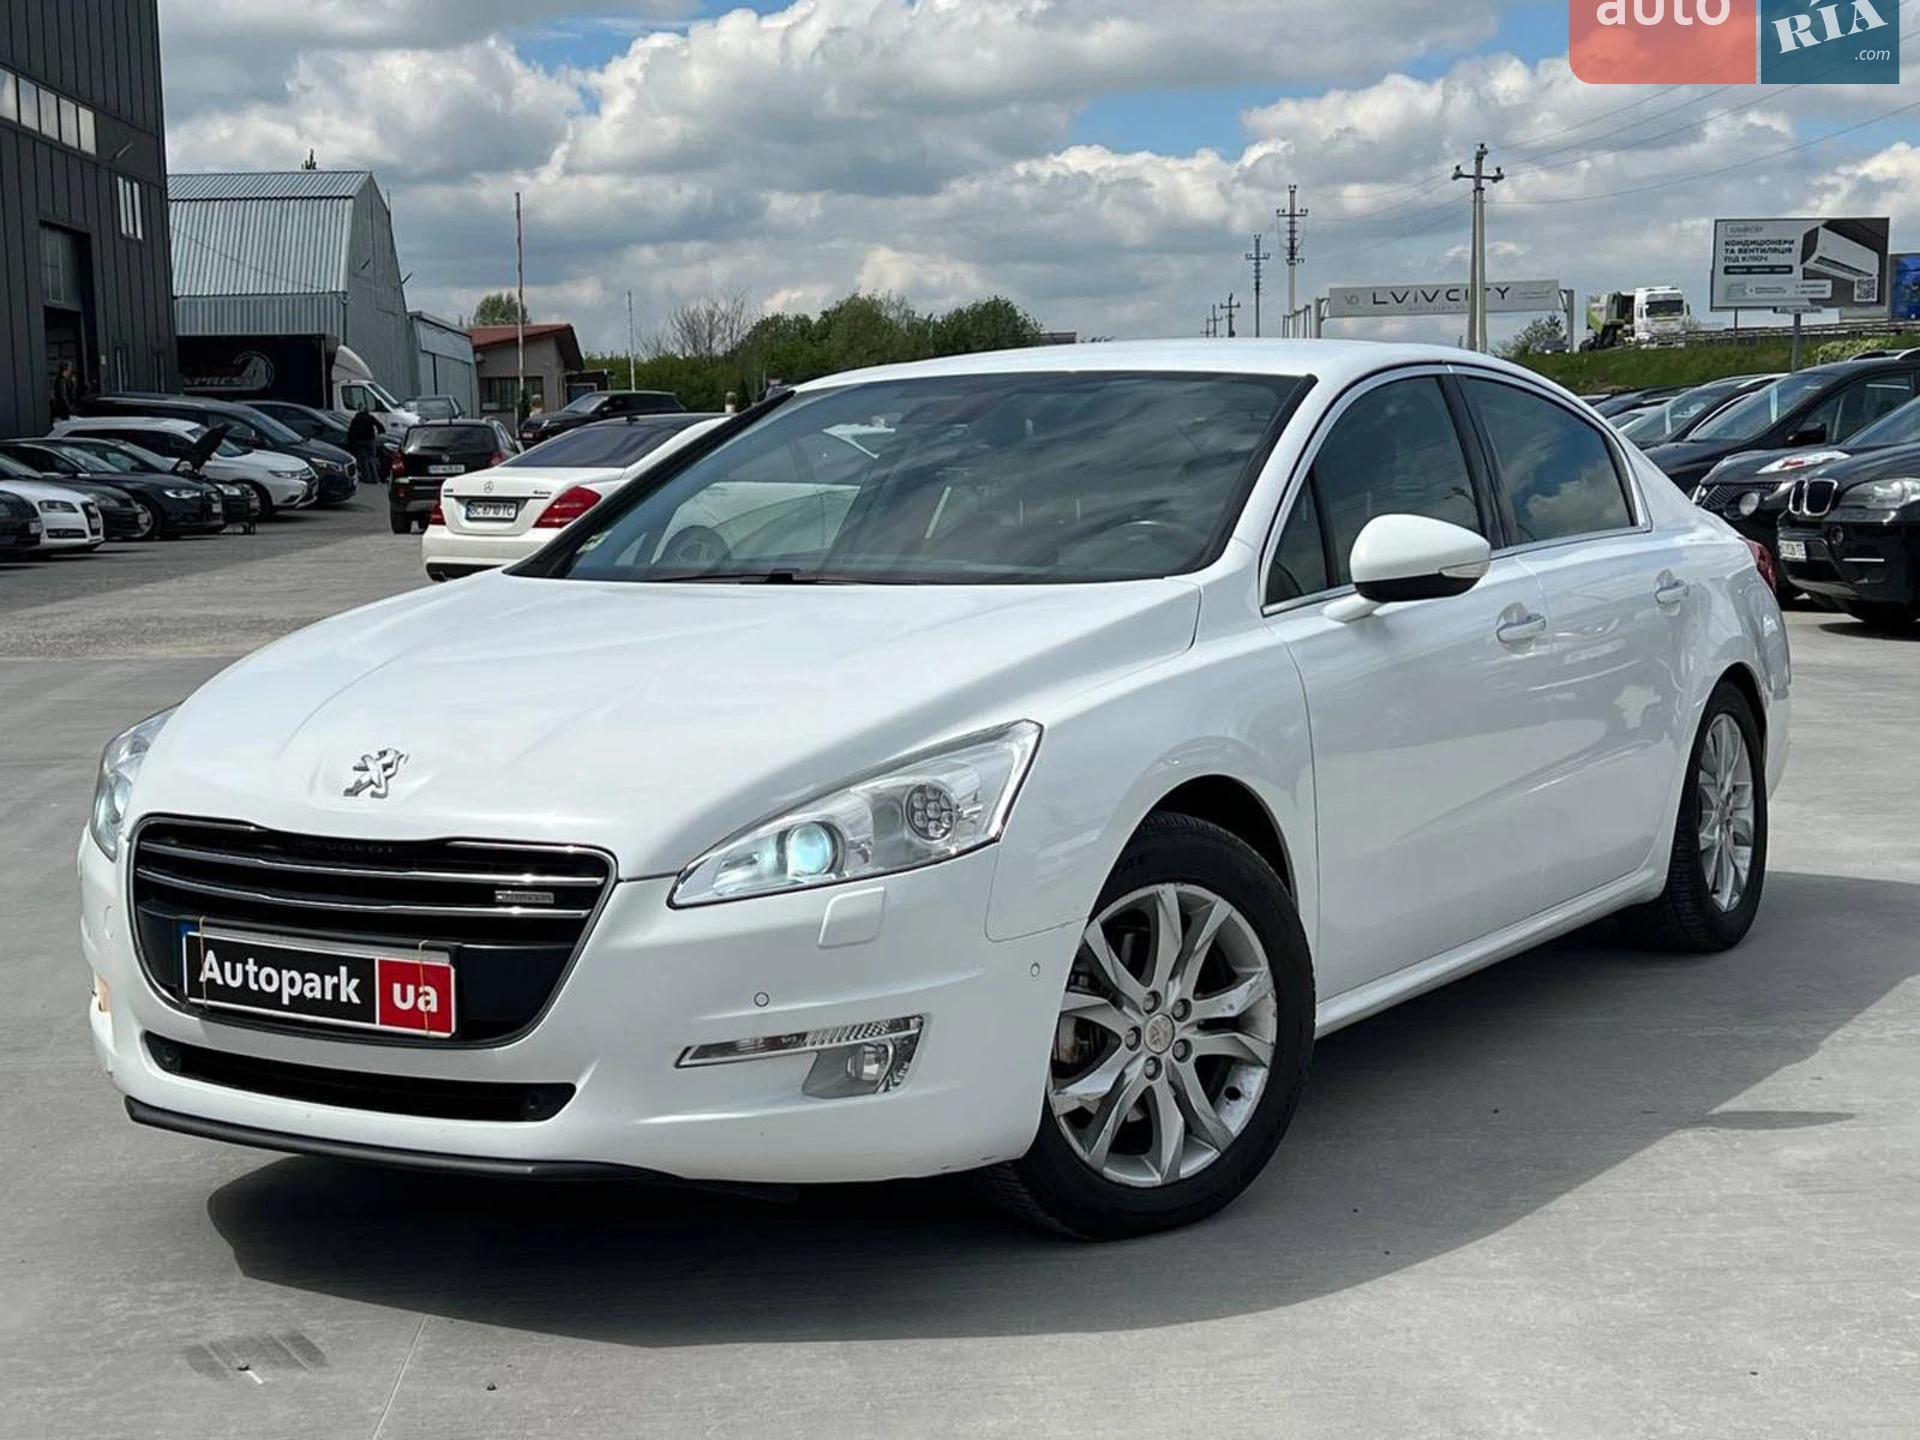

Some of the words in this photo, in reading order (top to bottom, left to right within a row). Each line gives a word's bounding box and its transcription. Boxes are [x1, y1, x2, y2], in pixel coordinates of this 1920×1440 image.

[1372, 287, 1511, 305] LVIVCIY
[199, 949, 361, 1005] Autopark
[392, 981, 438, 1013] ua
